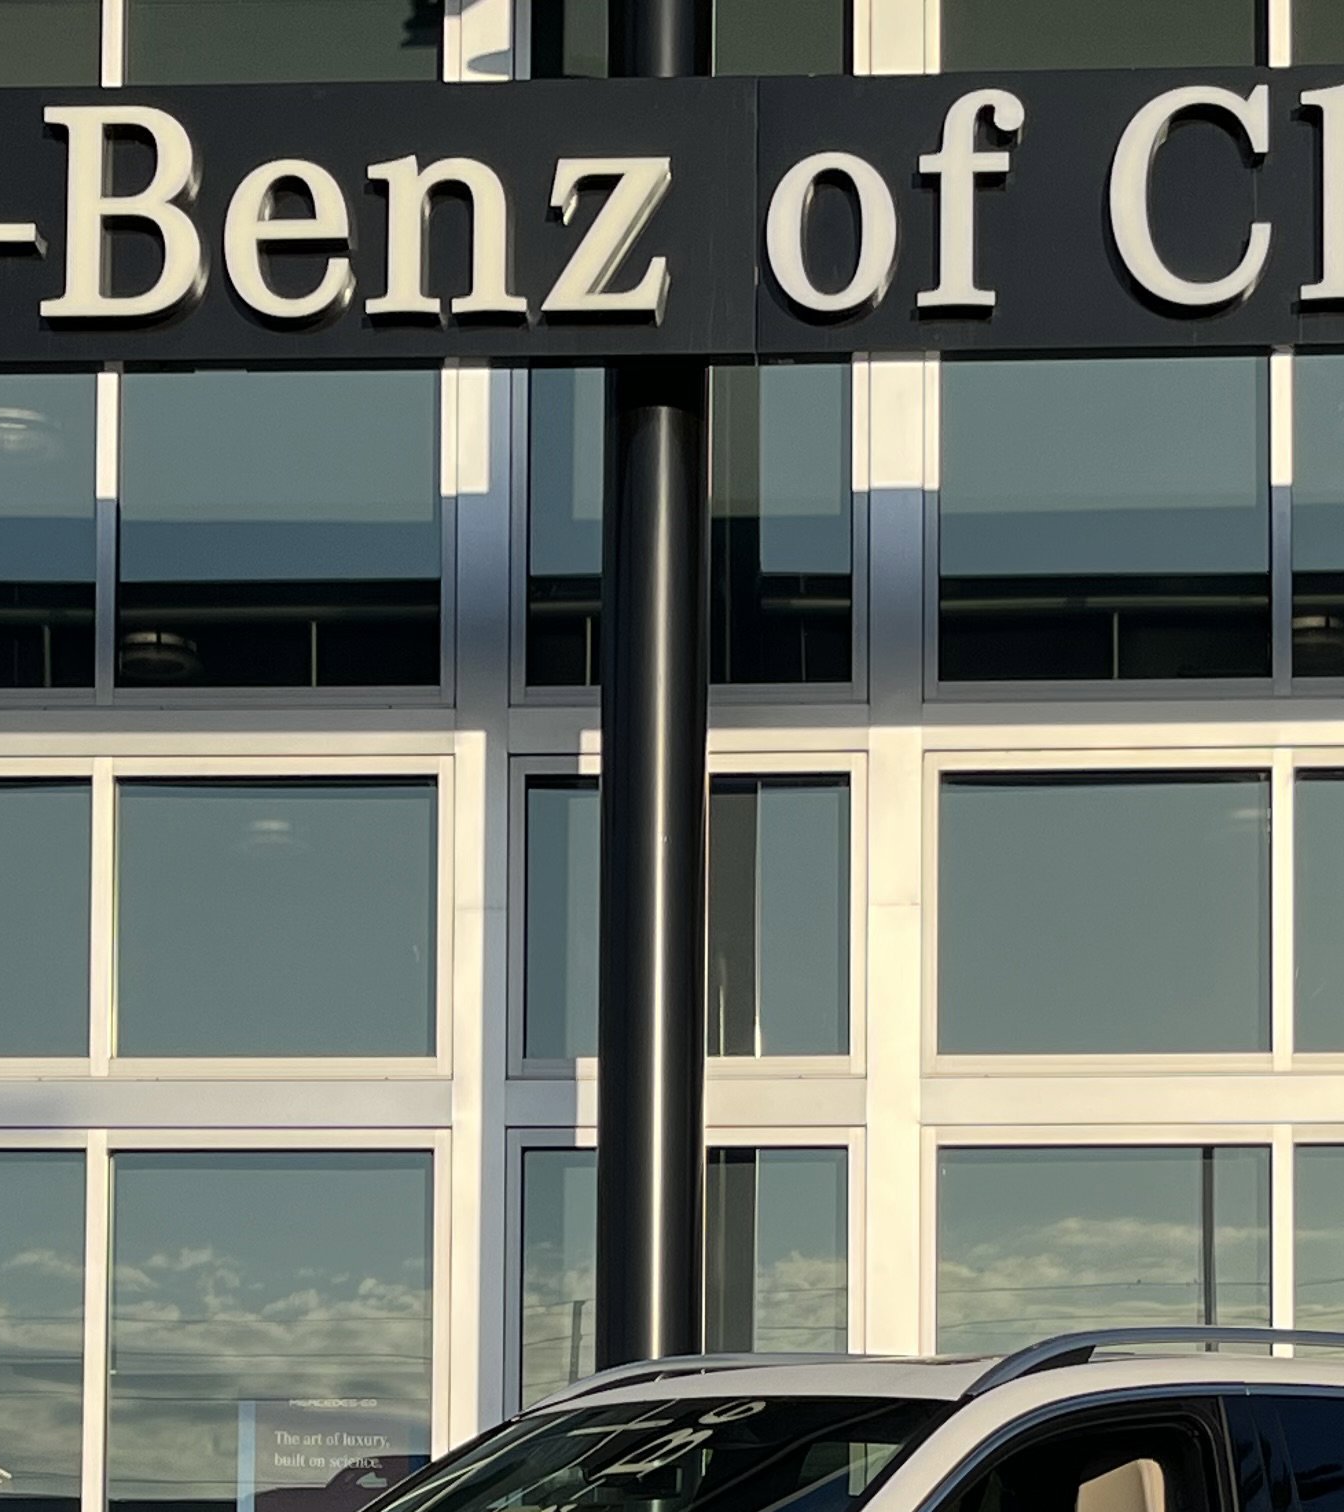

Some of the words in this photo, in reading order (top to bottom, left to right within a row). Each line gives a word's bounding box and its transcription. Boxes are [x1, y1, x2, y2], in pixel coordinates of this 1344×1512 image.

[765, 88, 1026, 316] of
[275, 1431, 300, 1445] The
[303, 1434, 322, 1445] art
[326, 1433, 340, 1446] of
[274, 1452, 305, 1467] built
[309, 1457, 325, 1467] on
[330, 1455, 383, 1469] science.
